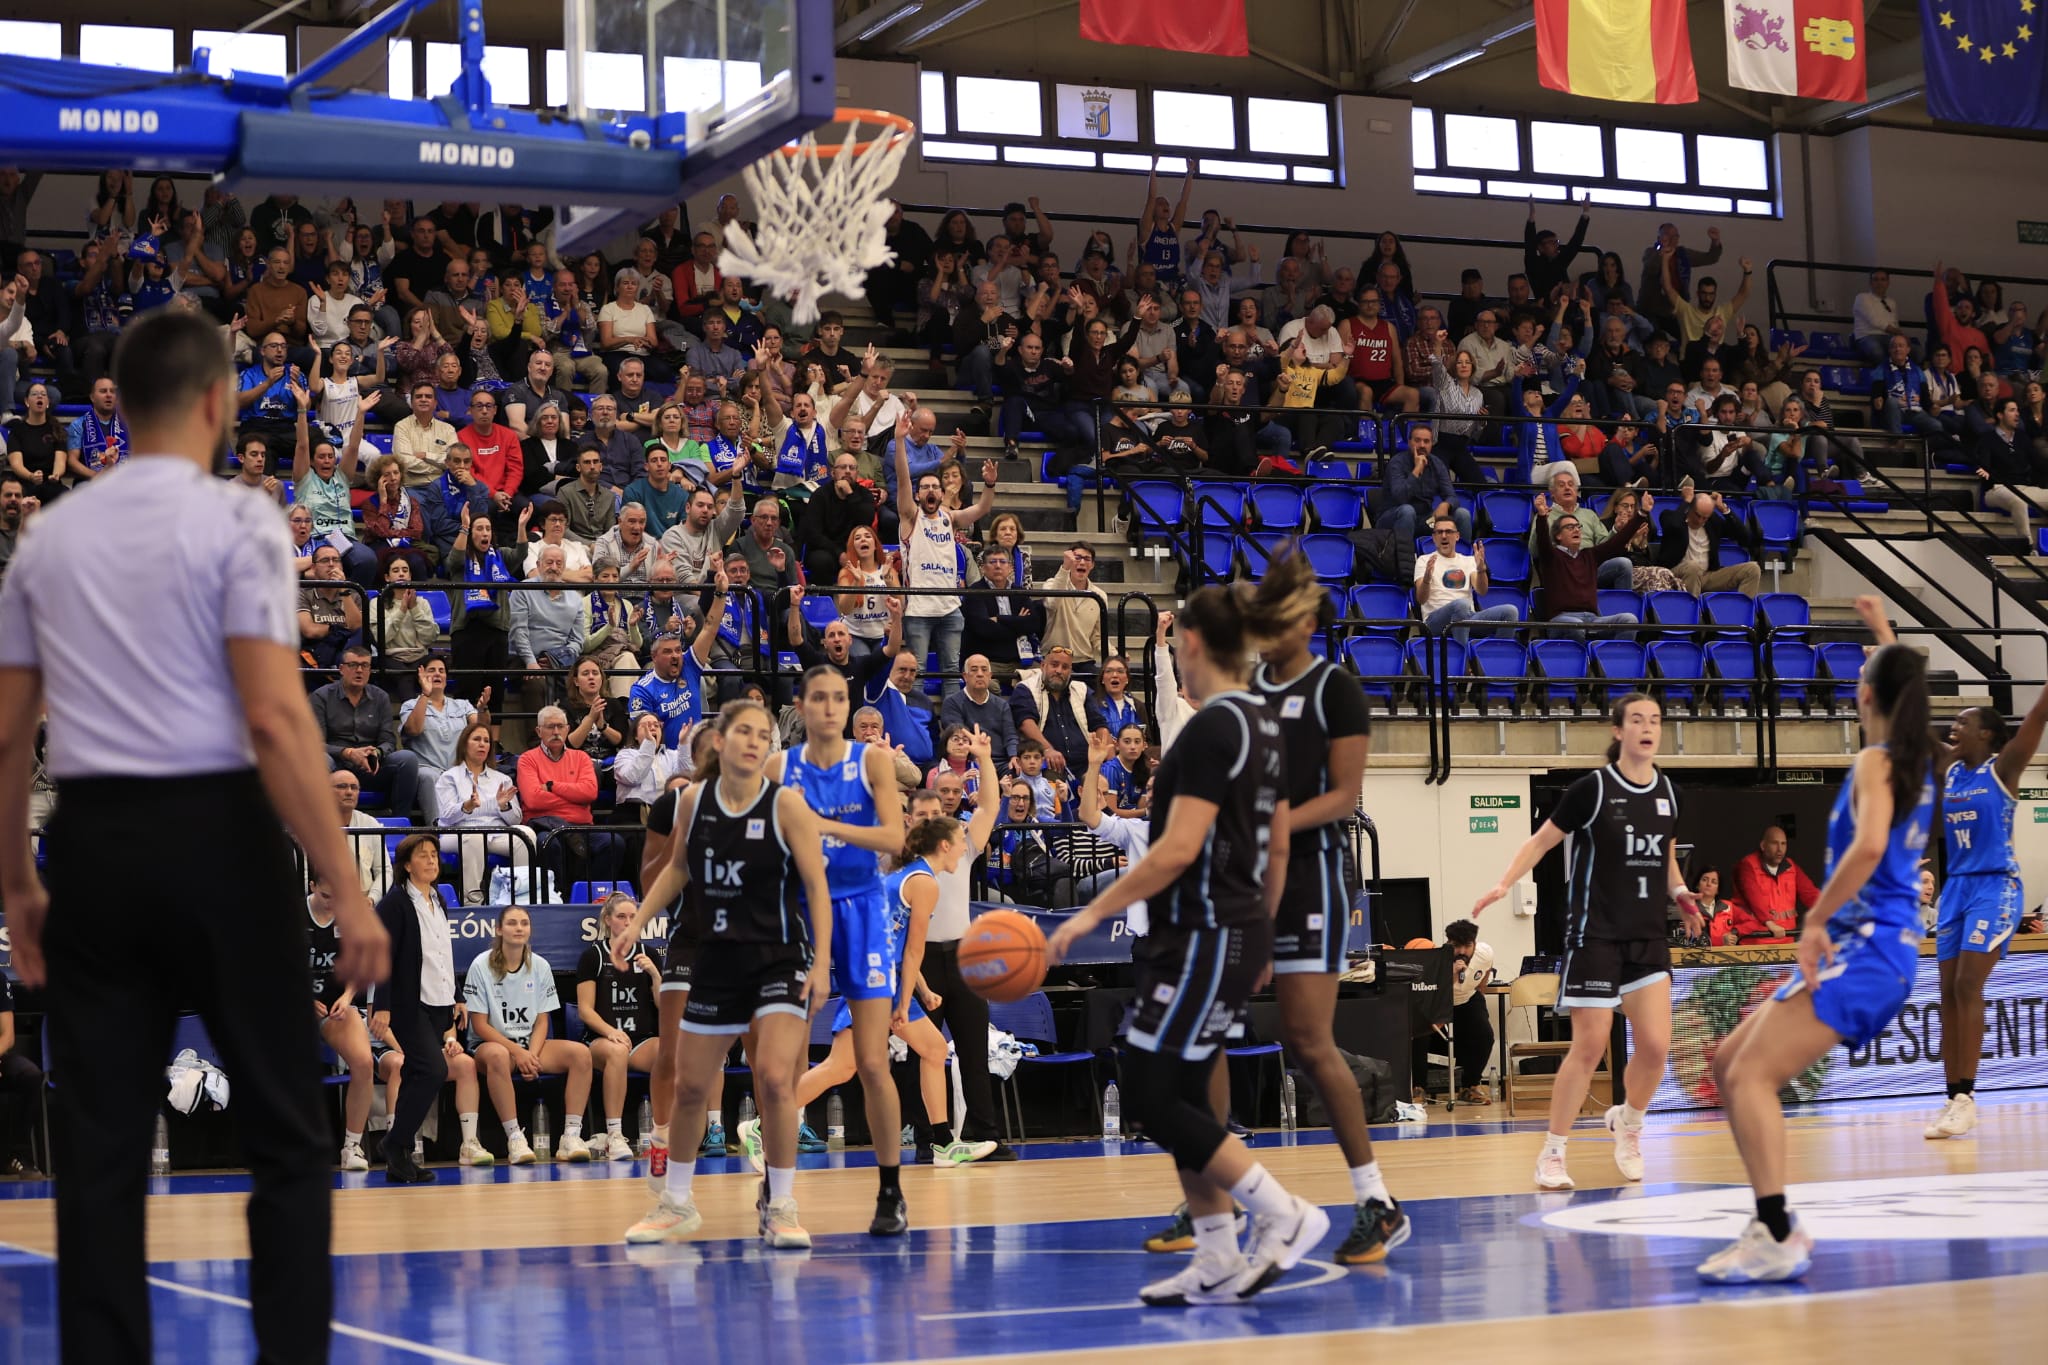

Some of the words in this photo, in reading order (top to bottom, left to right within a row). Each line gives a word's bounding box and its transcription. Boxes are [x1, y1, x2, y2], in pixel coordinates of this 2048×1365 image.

[59, 108, 159, 133] MONDO
[420, 141, 515, 168] MONDO
[1357, 338, 1388, 348] MIAMI
[1370, 349, 1387, 362] 22
[867, 597, 876, 610] 6
[1786, 772, 1815, 782] SALIDA
[1474, 797, 1504, 808] SALIDA
[1479, 821, 1491, 829] DEA
[1637, 876, 1649, 899] 1
[615, 1017, 632, 1032] 14
